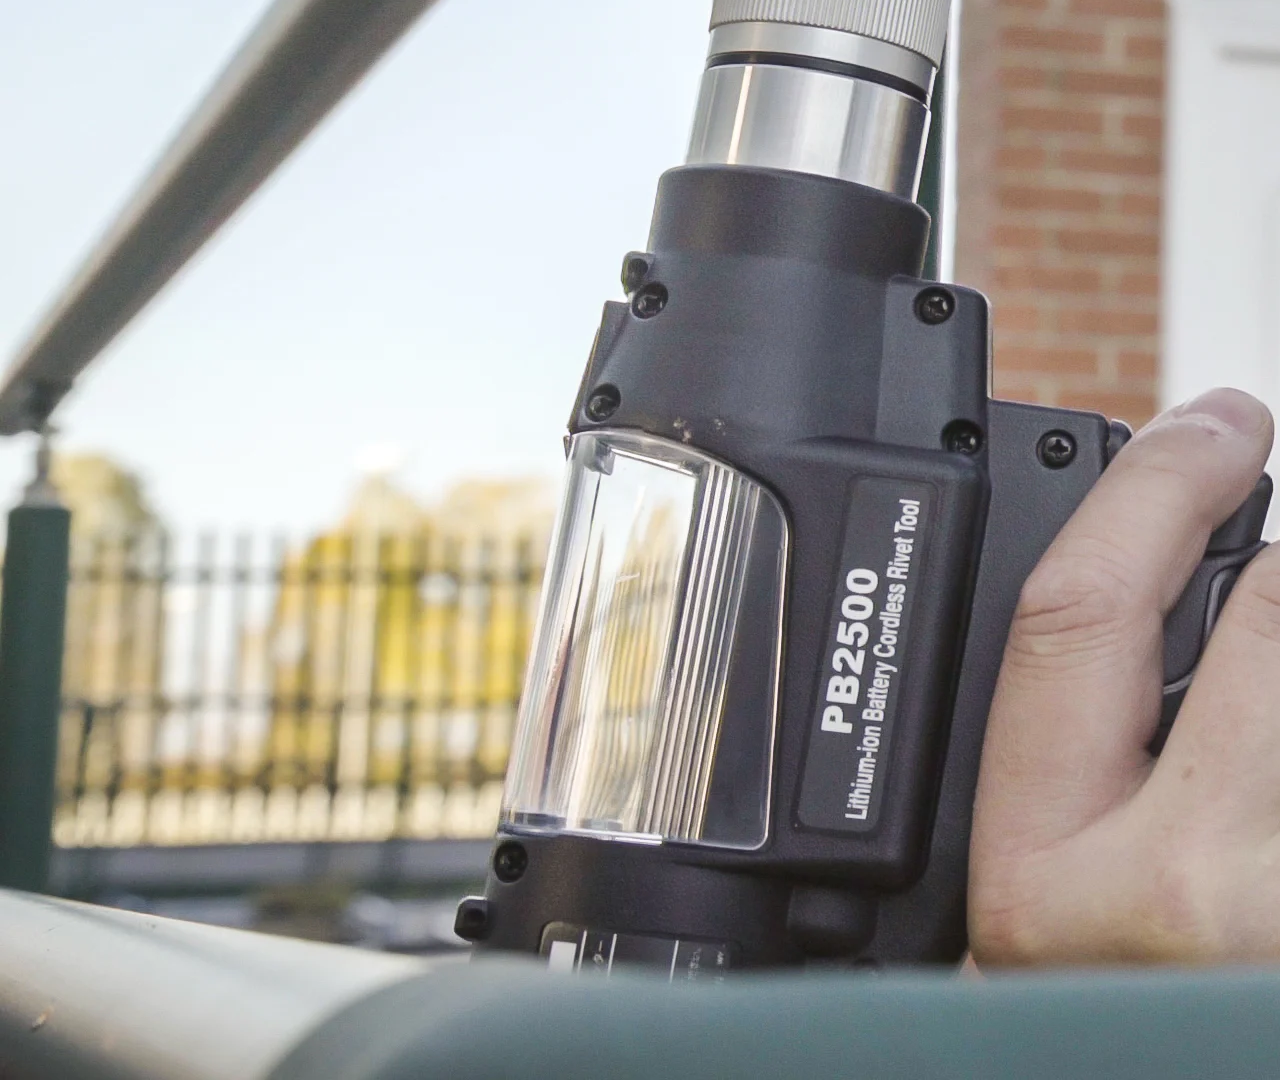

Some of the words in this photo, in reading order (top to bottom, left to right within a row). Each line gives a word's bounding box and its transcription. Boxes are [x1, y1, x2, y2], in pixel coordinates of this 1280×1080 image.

[893, 498, 920, 533] Tool
[886, 536, 914, 580] Rivet
[821, 568, 878, 734] PB2500
[872, 583, 907, 658] Cordless
[861, 660, 898, 722] Battery
[844, 725, 882, 820] Lithium-ion
